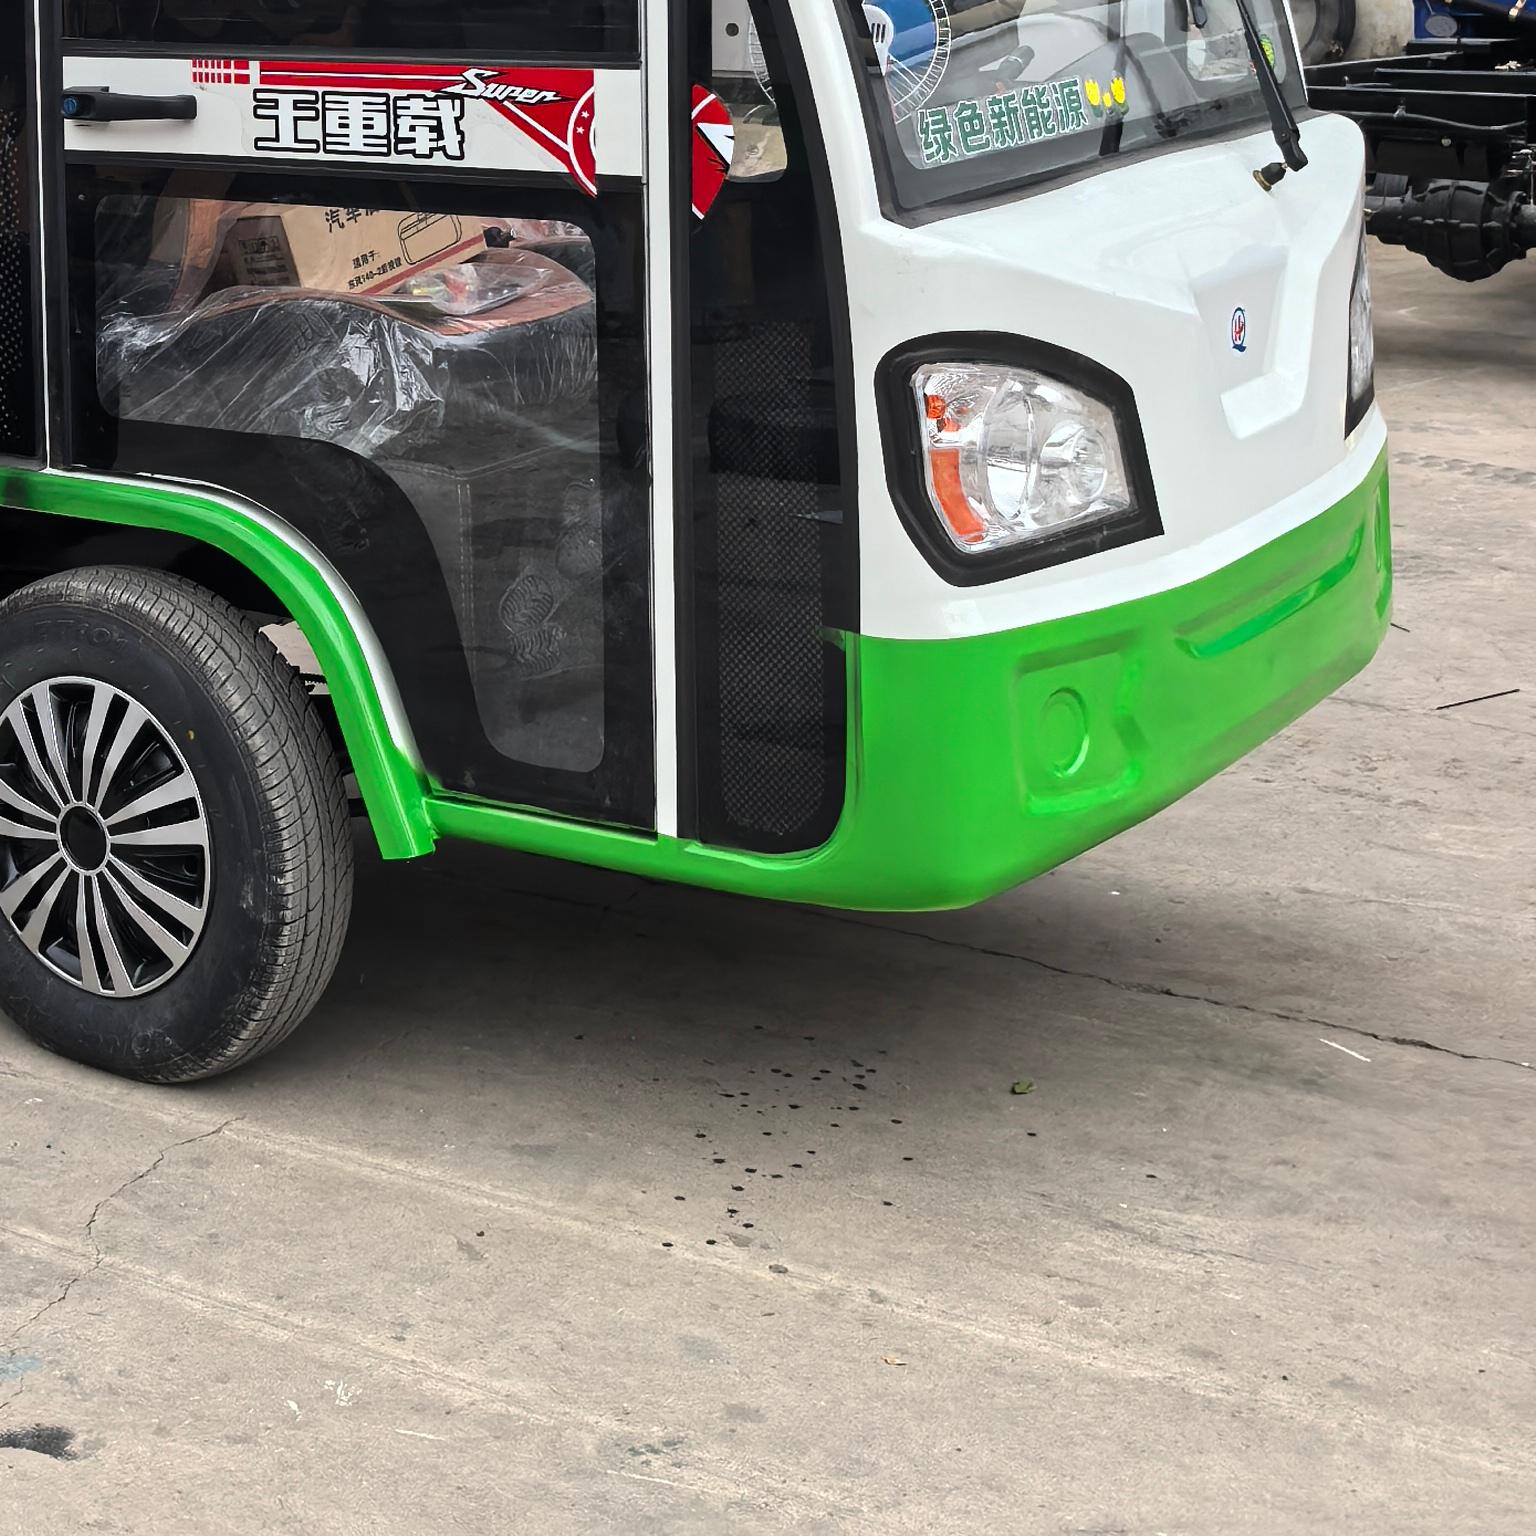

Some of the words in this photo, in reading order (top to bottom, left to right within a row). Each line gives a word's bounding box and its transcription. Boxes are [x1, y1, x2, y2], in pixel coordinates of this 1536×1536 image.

[440, 67, 567, 103] Super
[917, 76, 1089, 163] 绿色新能源
